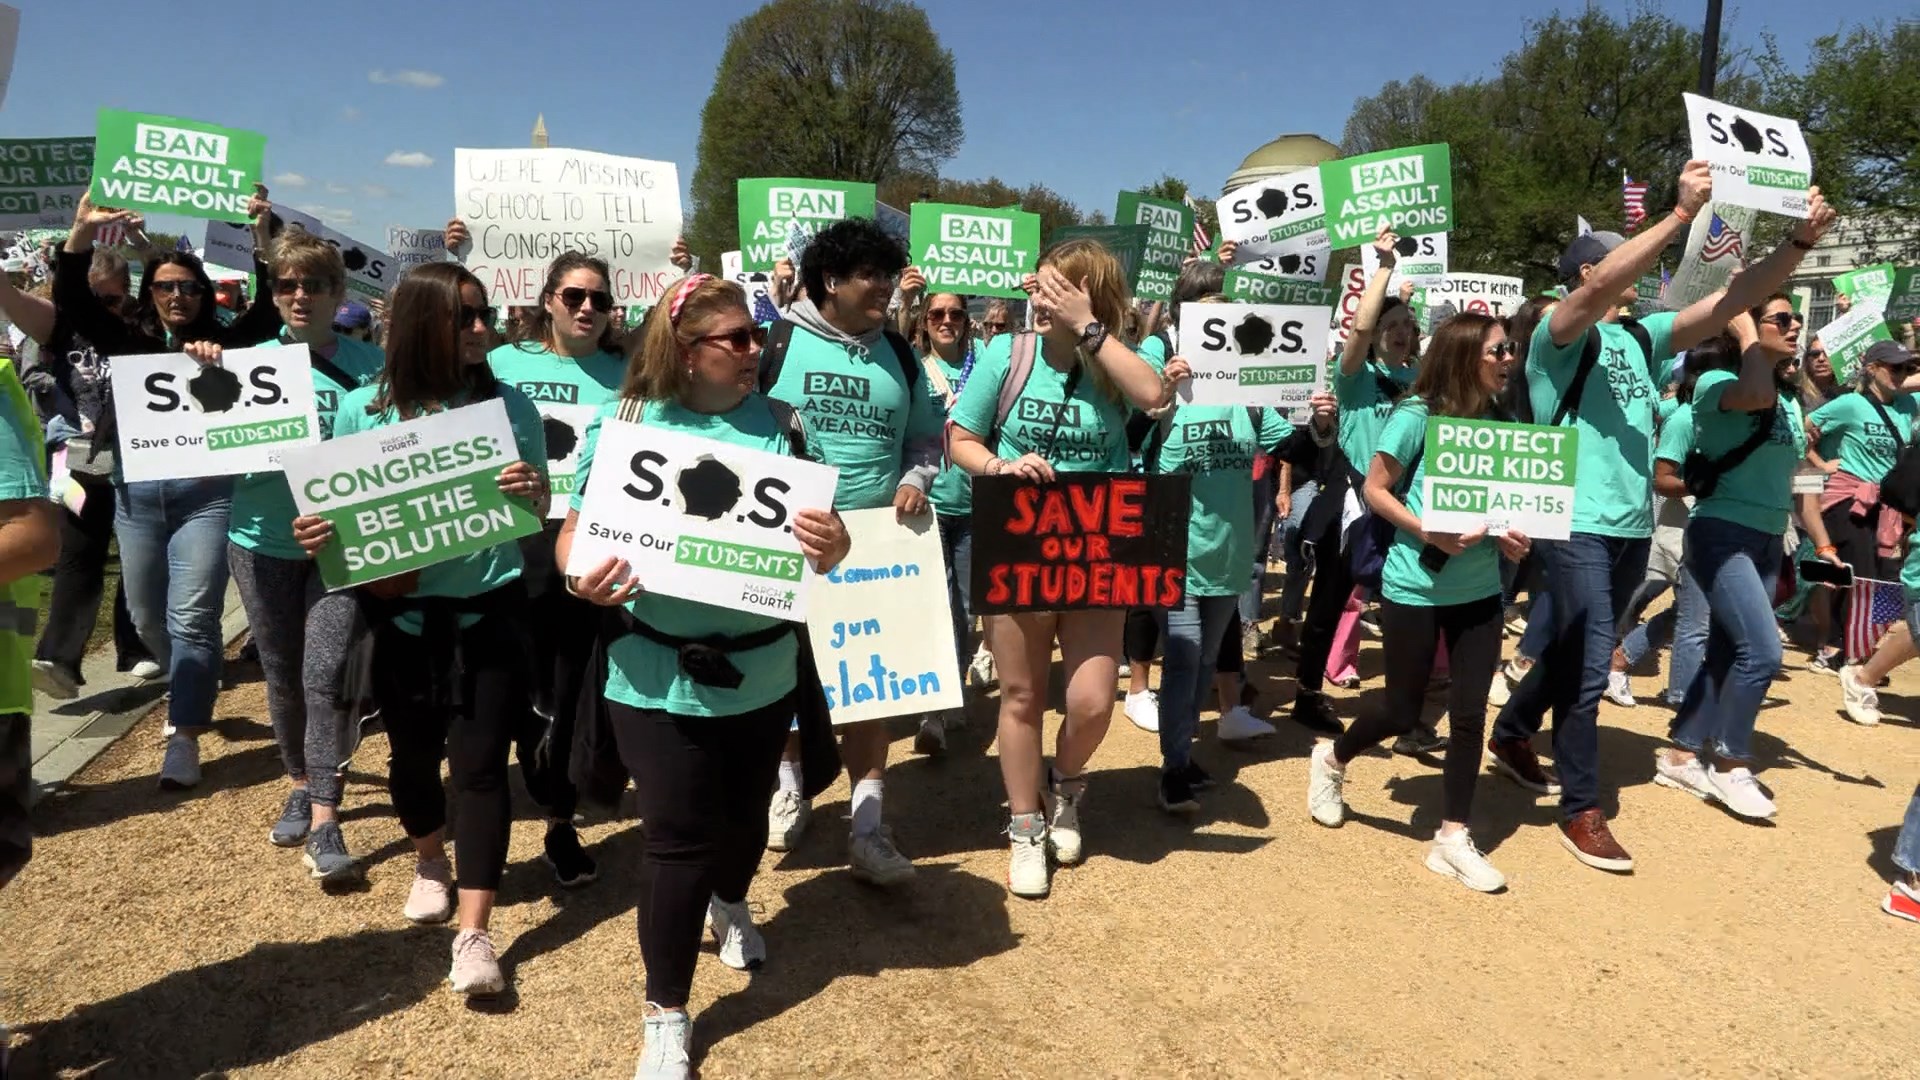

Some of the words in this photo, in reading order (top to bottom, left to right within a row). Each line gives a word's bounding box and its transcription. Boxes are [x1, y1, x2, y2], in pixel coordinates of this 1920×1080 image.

[0, 143, 95, 161] ROTECT
[145, 129, 218, 159] BAN
[45, 165, 90, 182] KID
[112, 156, 246, 189] ASSAULT
[559, 158, 655, 190] MISSING
[100, 177, 250, 214] WEAPONS
[467, 187, 552, 221] SCHOOL
[552, 191, 584, 221] TO
[596, 192, 654, 224] TELL
[776, 192, 836, 214] BAN
[1340, 184, 1440, 219] ASSAULT
[948, 218, 1005, 242] BAN
[1140, 205, 1178, 231] BAN
[1334, 206, 1448, 241] WEAPONS
[483, 223, 600, 260] CONGRESS
[605, 228, 634, 259] TO
[923, 243, 1028, 269] ASSAULT
[1234, 277, 1333, 305] PROTECT
[810, 375, 865, 398] BAN
[1191, 372, 1212, 380] ave
[1216, 371, 1237, 380] Our
[1240, 368, 1314, 383] STUDENTS
[522, 385, 572, 402] BAN
[802, 397, 895, 424] ASSAULT
[130, 436, 170, 450] Save
[175, 434, 205, 447] Our
[208, 420, 305, 448] STUDENTS
[381, 438, 419, 453] FOURTH
[1187, 422, 1230, 441] BAN
[1437, 423, 1566, 455] PROTECT
[303, 436, 503, 504] CONGRESS:
[1436, 451, 1495, 477] OUR
[1502, 456, 1564, 482] KIDS
[355, 503, 405, 538] BE
[407, 483, 478, 522] THE
[1005, 479, 1147, 538] SAVE
[1436, 487, 1486, 509] NOT
[1490, 492, 1565, 514] AR-15s
[344, 504, 516, 572] SOLUTION
[588, 521, 634, 545] Save
[639, 533, 675, 553] Our
[678, 539, 799, 578] STUDENTS
[1041, 533, 1112, 561] OUR
[743, 582, 784, 598] MARCH
[985, 562, 1185, 607] STUDENTS
[741, 591, 793, 612] FOURTH
[830, 618, 881, 649] gun
[823, 653, 941, 711] slation
